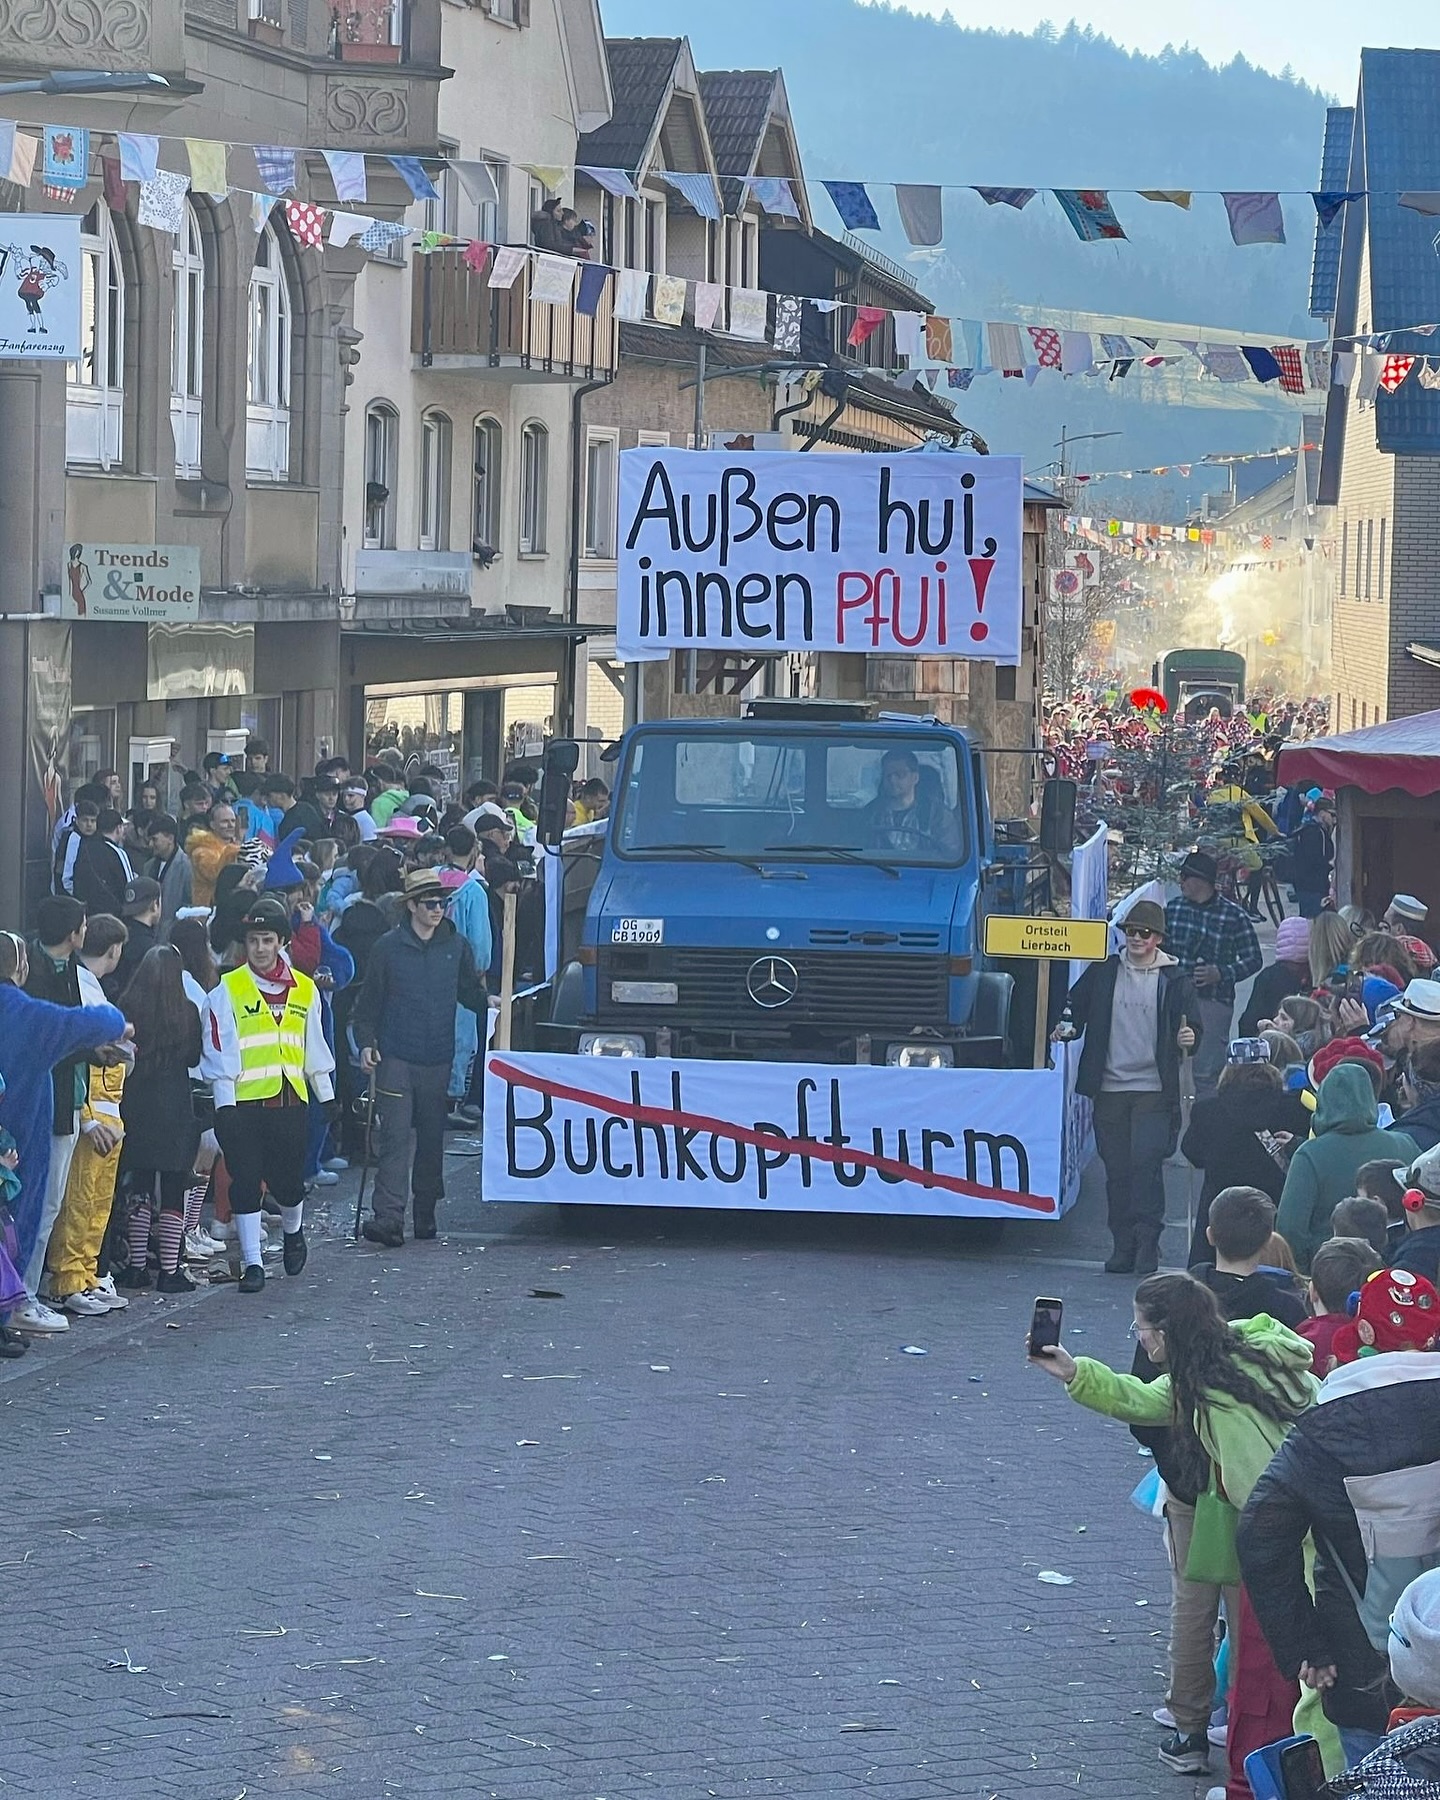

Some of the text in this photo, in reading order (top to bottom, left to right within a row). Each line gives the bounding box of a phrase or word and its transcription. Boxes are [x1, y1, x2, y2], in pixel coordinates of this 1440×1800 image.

[0, 338, 65, 354] Fanfarenzug
[625, 460, 998, 567] Außen hui,
[95, 549, 169, 568] Trends
[102, 569, 194, 603] & Mode
[638, 556, 813, 641] innen
[93, 606, 167, 617] Susanne Vollmer
[622, 919, 638, 930] OG
[1025, 924, 1068, 937] Ortsteil
[613, 931, 628, 942] CB
[1021, 939, 1071, 952] Lierbach
[506, 1070, 1030, 1200] Buchkopfturm
